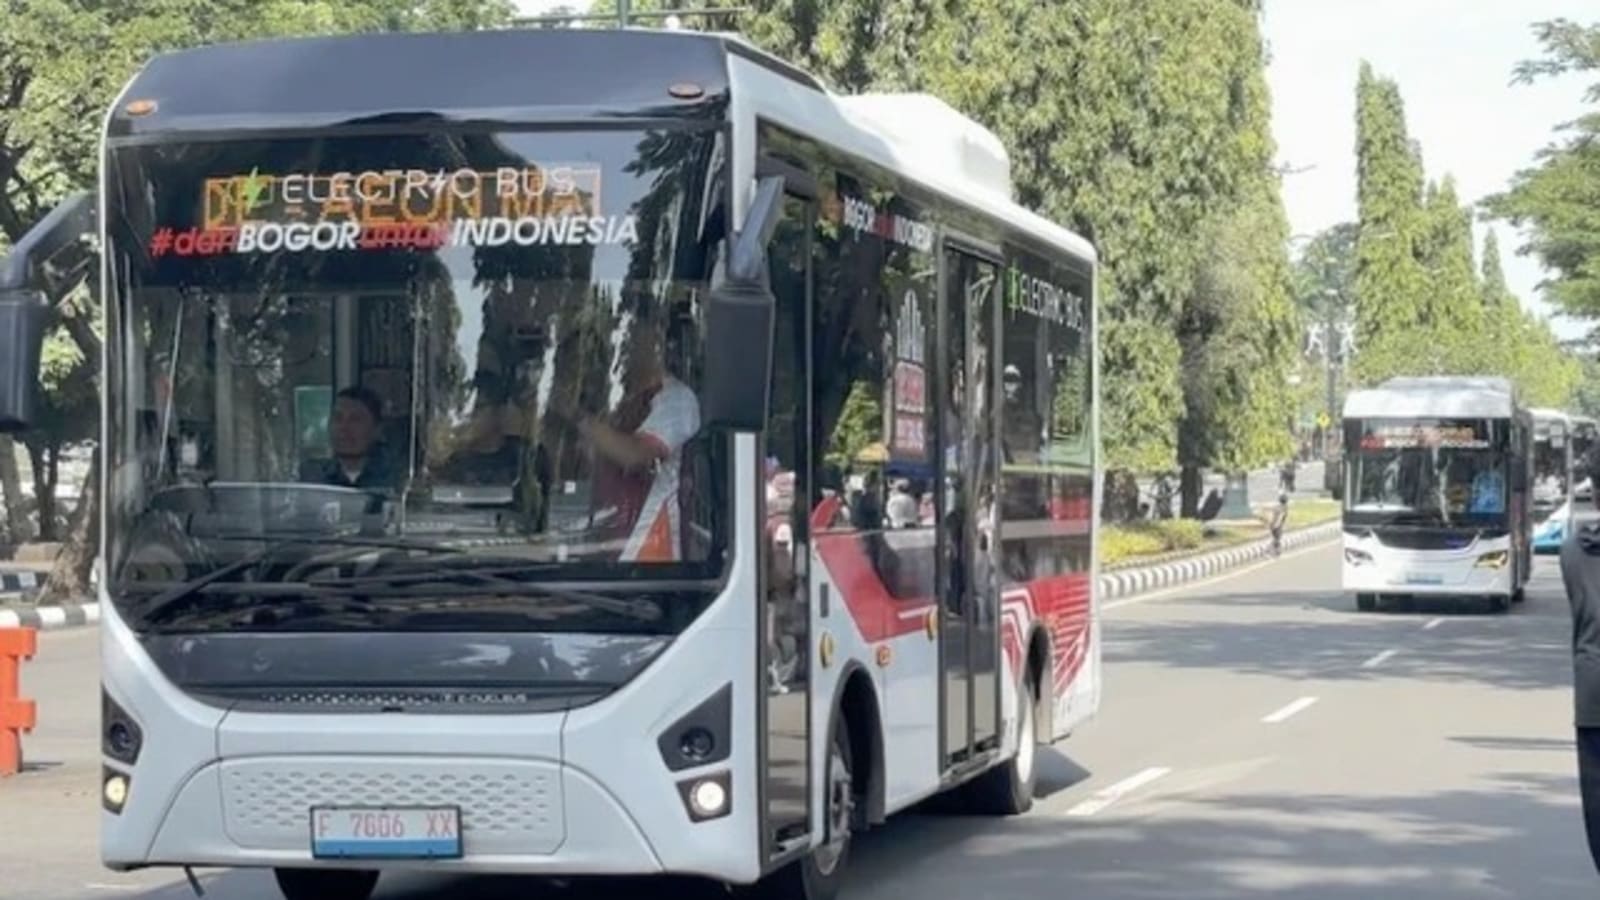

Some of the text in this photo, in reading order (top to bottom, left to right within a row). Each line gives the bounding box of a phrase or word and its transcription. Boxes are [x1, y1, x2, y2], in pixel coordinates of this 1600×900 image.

[497, 167, 575, 197] BUS
[319, 812, 331, 838] F
[425, 812, 454, 838] XX
